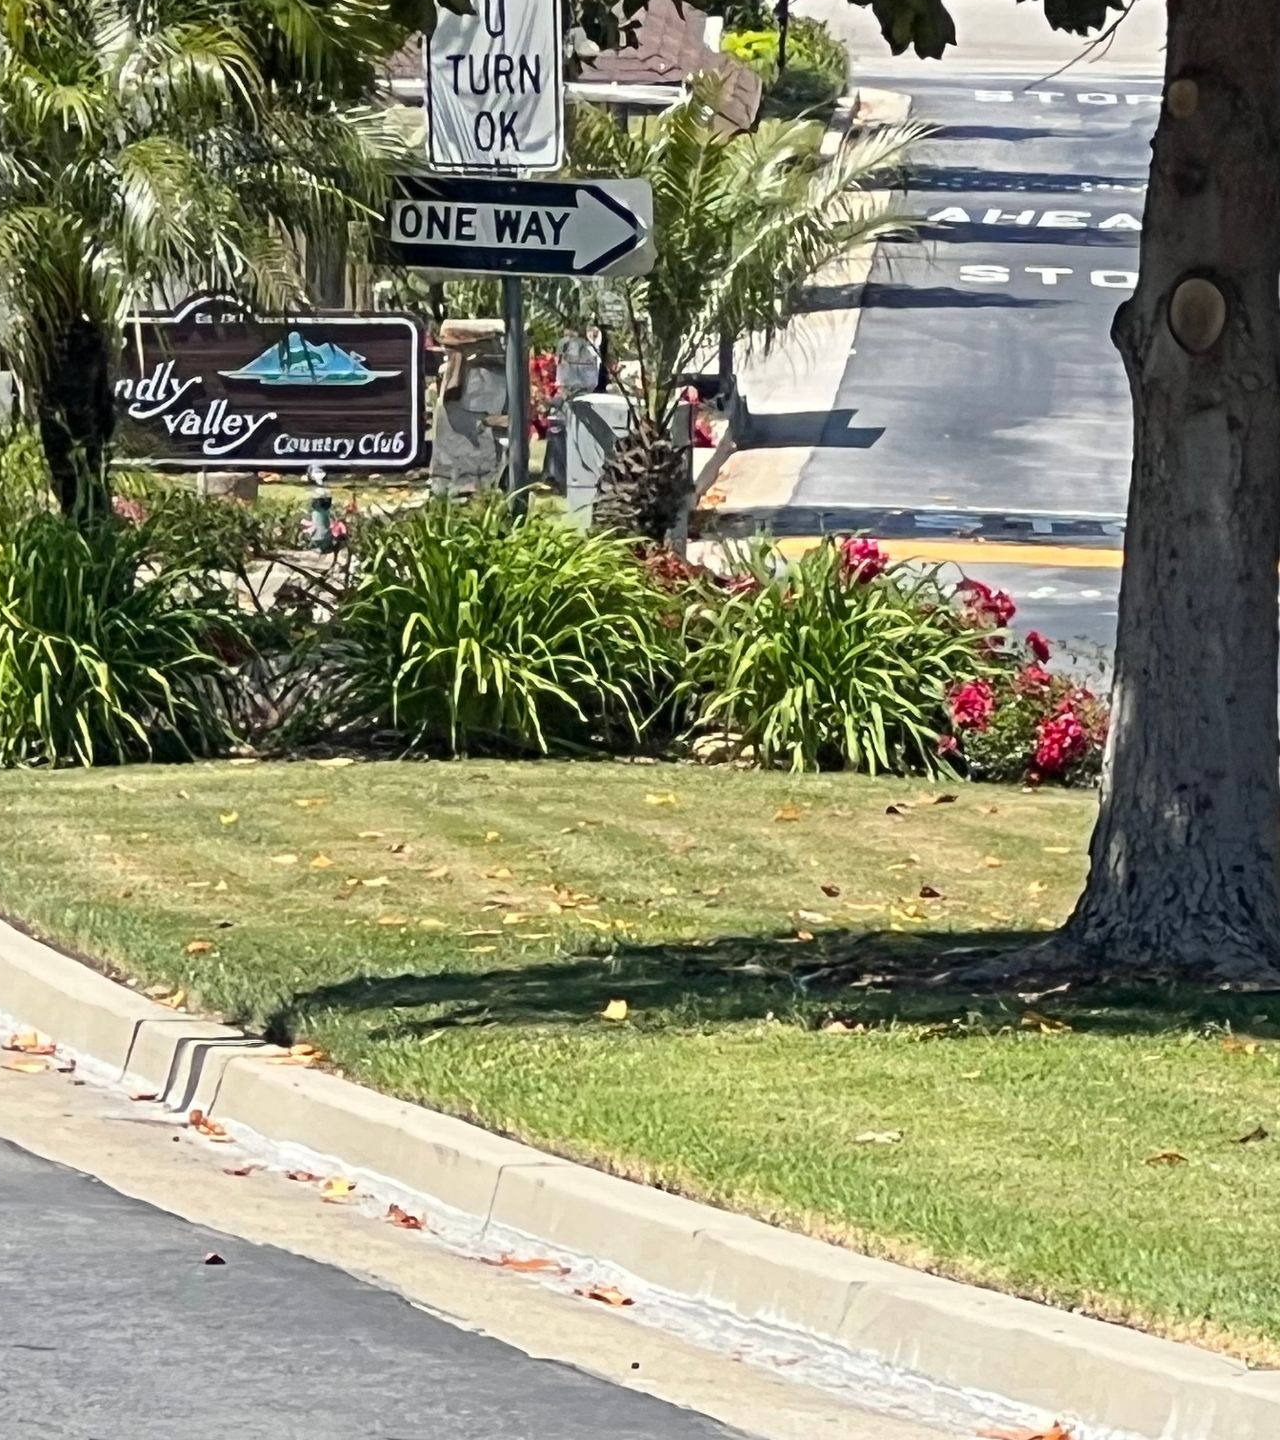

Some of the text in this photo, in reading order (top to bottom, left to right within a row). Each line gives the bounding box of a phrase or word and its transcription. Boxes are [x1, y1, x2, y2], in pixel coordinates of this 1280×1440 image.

[446, 54, 541, 96] TURN
[974, 89, 1164, 105] STOP
[475, 111, 520, 152] OK
[399, 203, 570, 246] ONE WAY
[927, 207, 1143, 231] AHEA
[959, 264, 1139, 289] STO
[273, 430, 406, 459] Country Club
